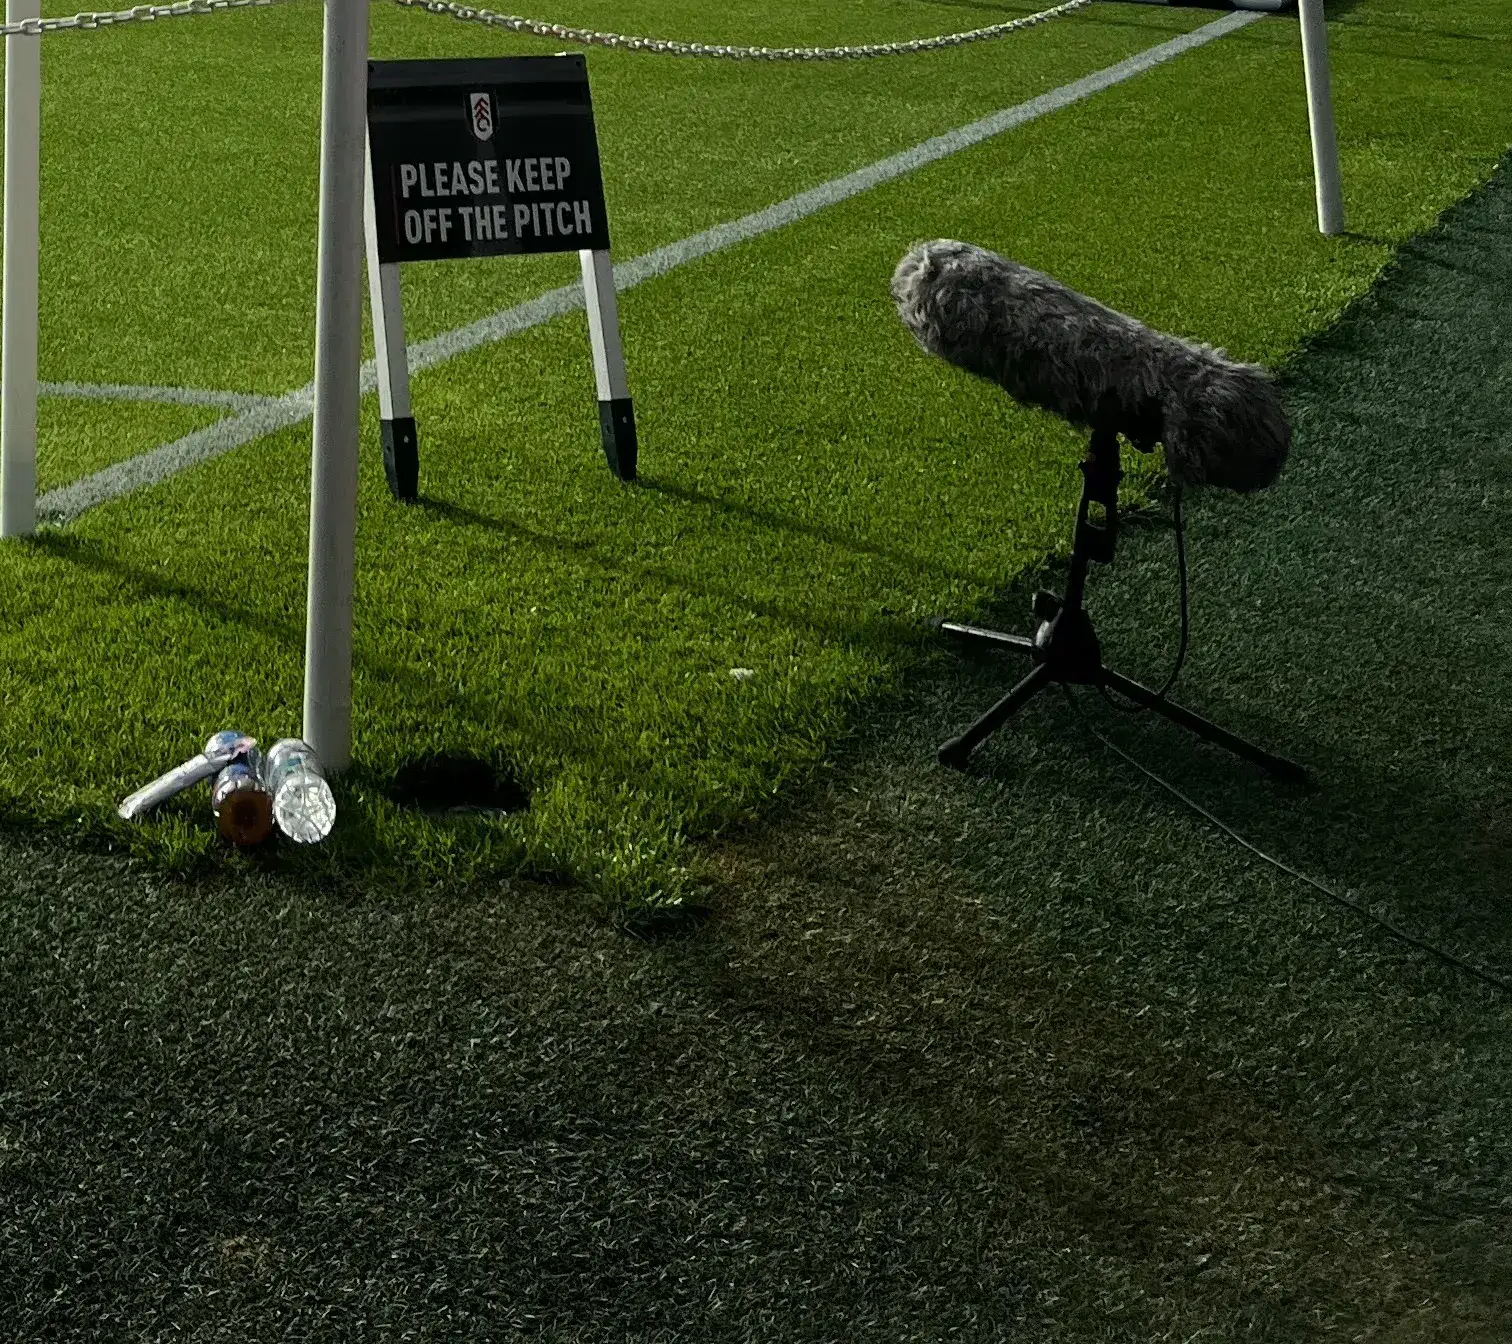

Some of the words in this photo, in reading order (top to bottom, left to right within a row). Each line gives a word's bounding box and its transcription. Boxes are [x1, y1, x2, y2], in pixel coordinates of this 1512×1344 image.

[399, 159, 501, 199] PLEASE
[504, 156, 572, 194] KEEP
[403, 206, 453, 245] OFF
[457, 203, 509, 242] THE
[512, 199, 593, 238] PITCH
